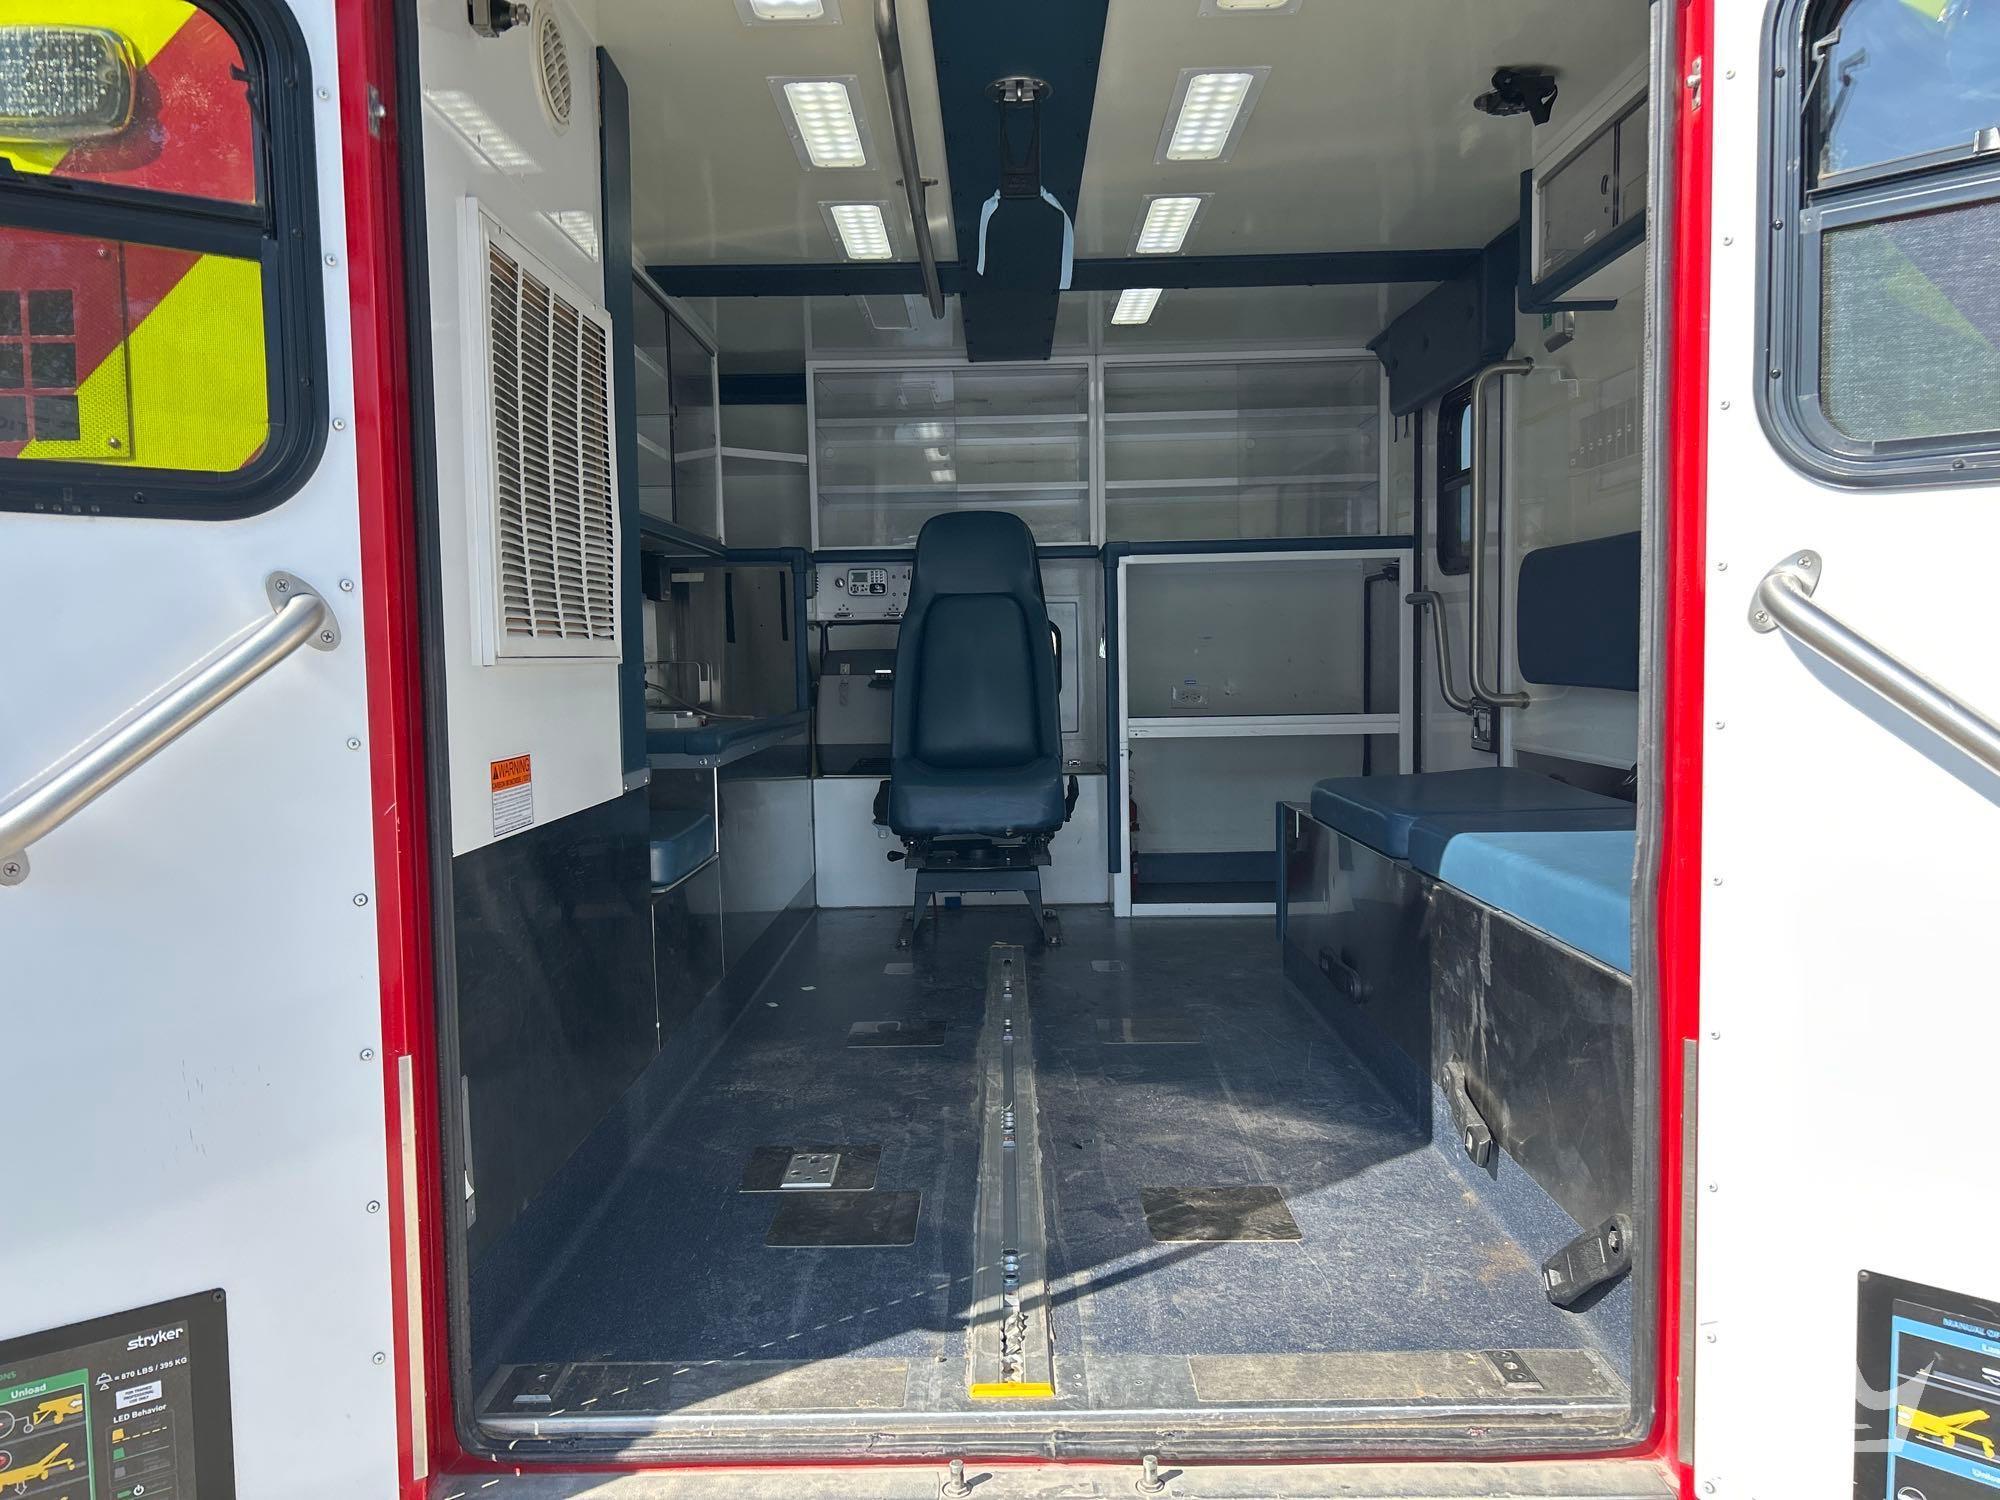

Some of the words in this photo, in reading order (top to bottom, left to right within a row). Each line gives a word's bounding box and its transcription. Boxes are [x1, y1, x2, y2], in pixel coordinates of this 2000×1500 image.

[498, 757, 530, 778] WARNING
[127, 1327, 184, 1351] stryker
[121, 1370, 136, 1381] 870
[136, 1364, 154, 1377] LBS
[159, 1359, 174, 1371] 395
[174, 1356, 188, 1366] KG
[11, 1383, 47, 1399] Unload
[113, 1412, 130, 1424] LED
[131, 1403, 167, 1419] Behavior
